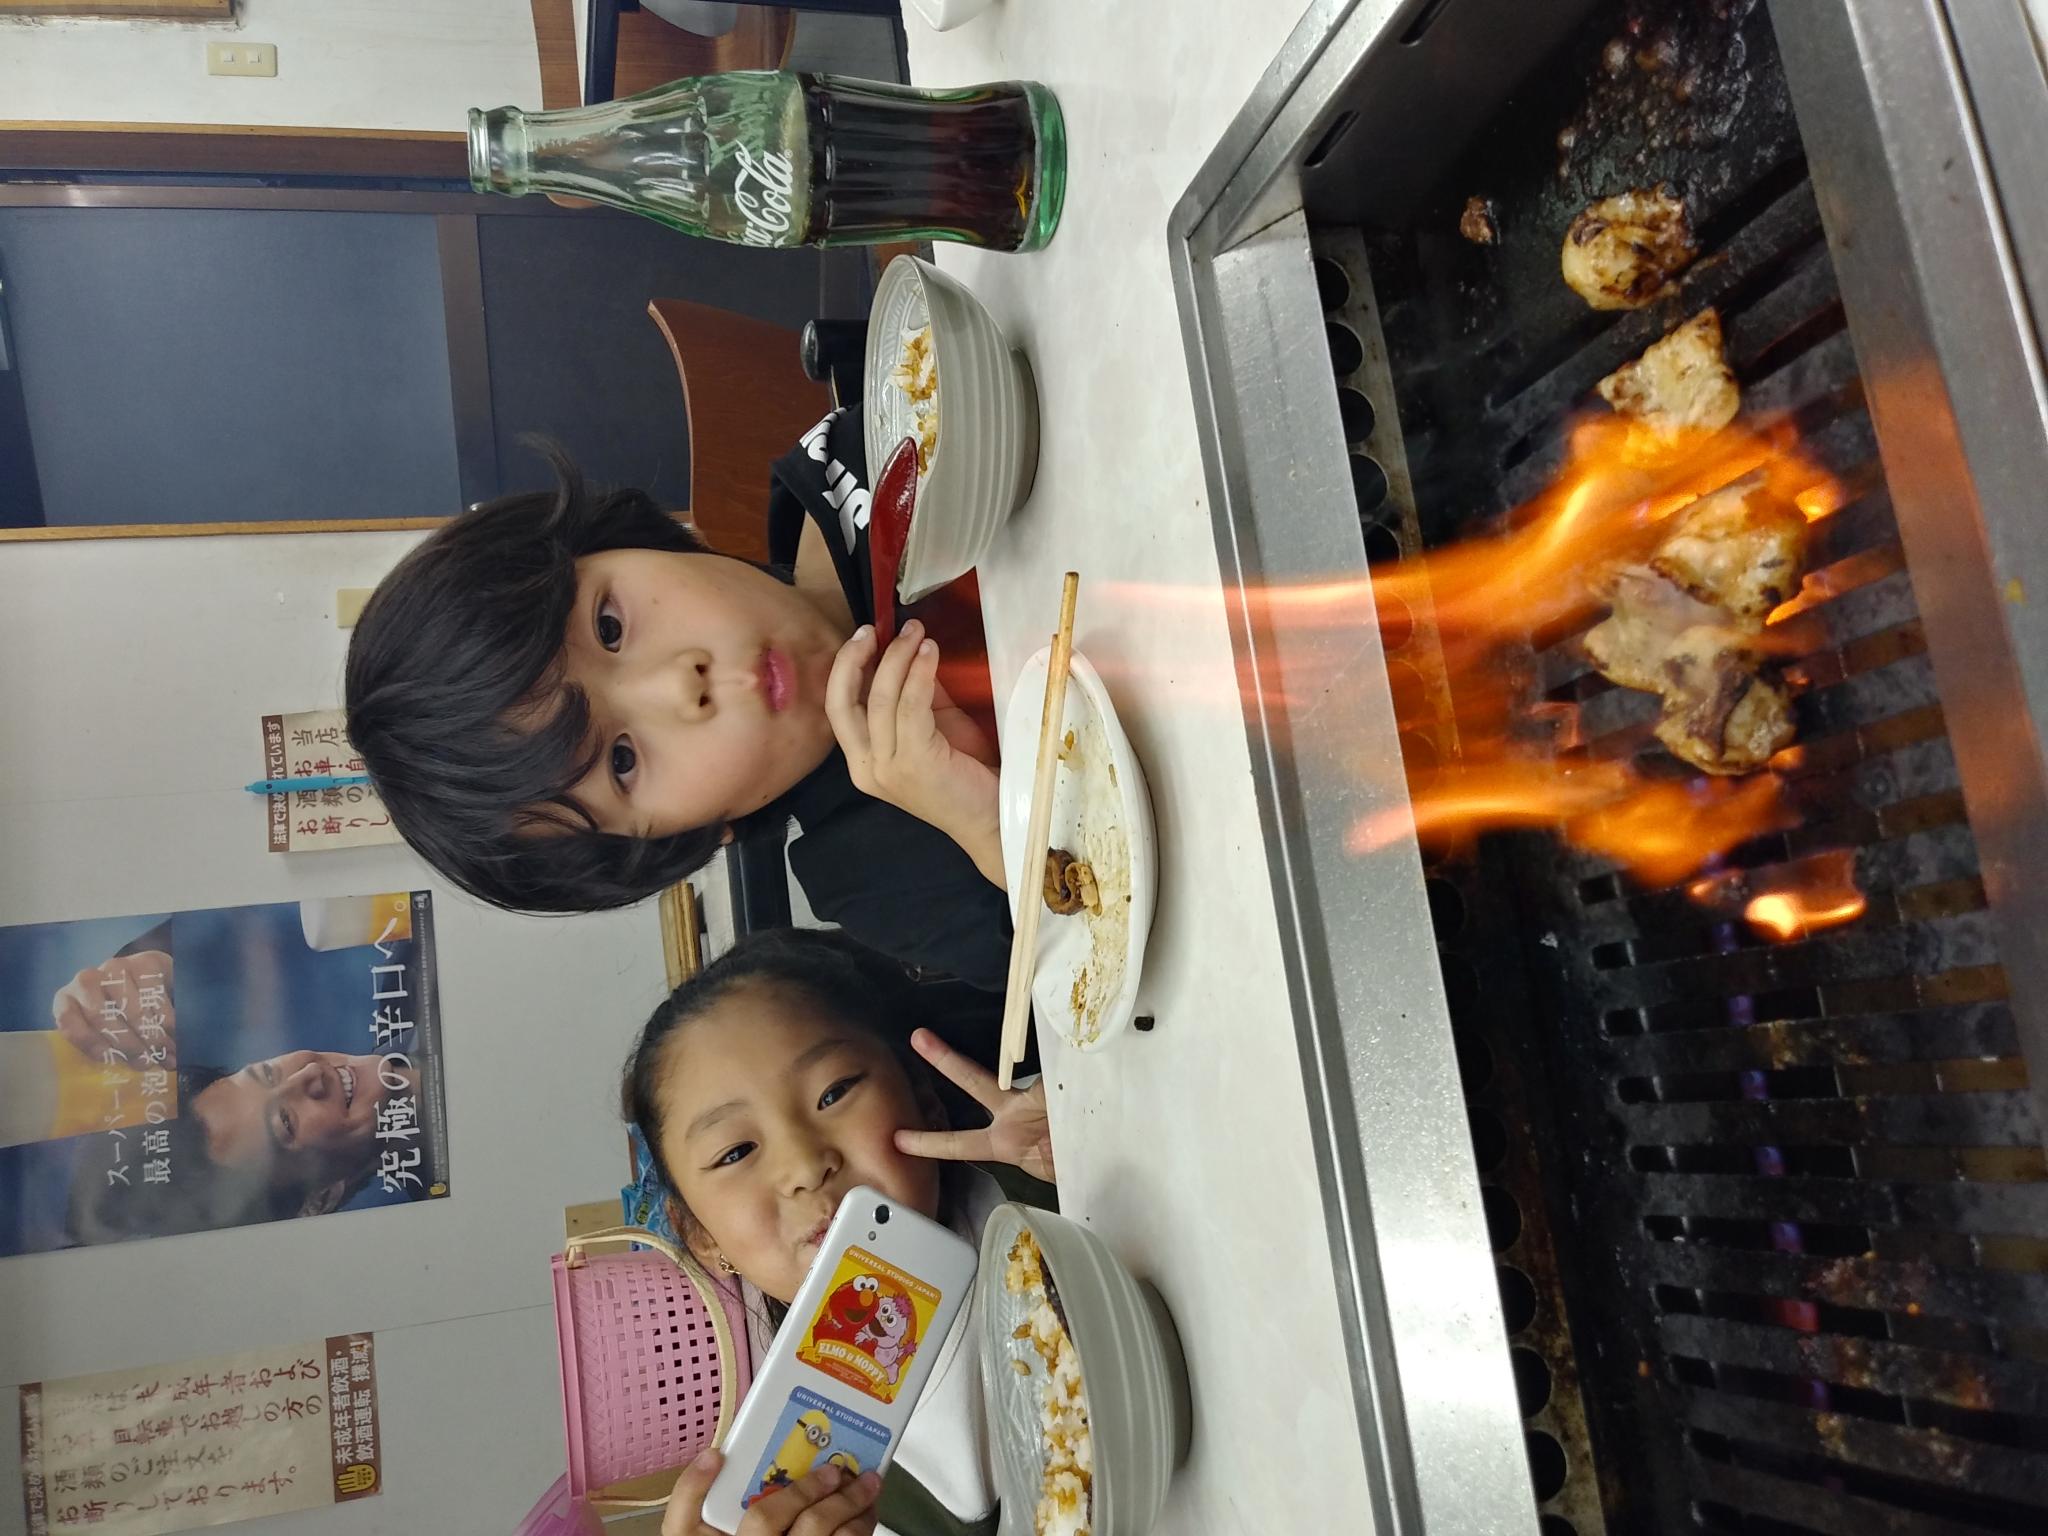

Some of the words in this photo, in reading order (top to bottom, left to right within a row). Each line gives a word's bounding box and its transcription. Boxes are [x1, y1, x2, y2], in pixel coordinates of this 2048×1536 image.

[291, 727, 348, 747] 当店
[267, 721, 287, 844] 法律で決めれています
[368, 900, 425, 1193] 究極の辛口へ。
[101, 968, 132, 1188] スーパードライ史上
[848, 1249, 886, 1273] UNIVERSAL
[886, 1268, 915, 1287] STUDIOS
[819, 1341, 845, 1361] ELMO
[852, 1355, 885, 1381] MOPPY
[352, 1388, 376, 1461] 飲酒運転
[796, 1389, 835, 1415] UNIVERSAL
[835, 1408, 864, 1429] STUDIOS
